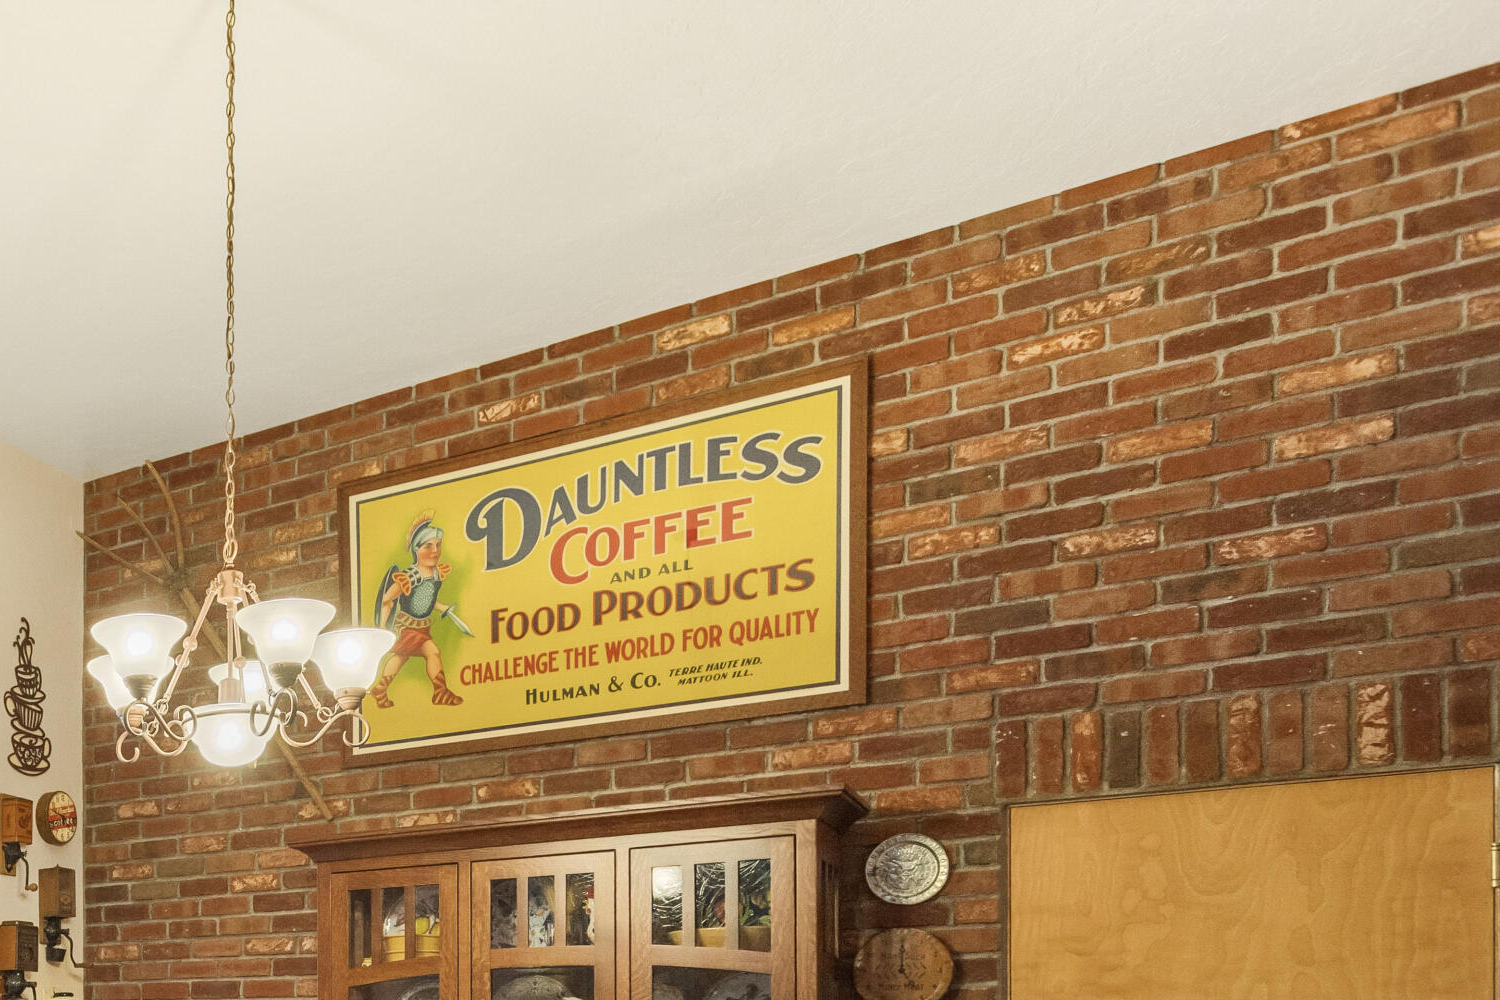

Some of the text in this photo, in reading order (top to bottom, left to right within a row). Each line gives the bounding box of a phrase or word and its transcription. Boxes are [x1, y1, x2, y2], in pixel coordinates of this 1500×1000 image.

[465, 432, 823, 571] DAUNTLESS
[550, 497, 752, 585] COFFEE
[610, 559, 693, 584] AND ALL
[491, 558, 816, 644] FOOD PRODUCTS
[460, 608, 820, 686] CHALLENGE THE WORLD FOR QUALITY
[668, 656, 763, 677] TERRE HAUTE IND.
[525, 683, 600, 705] HULMAN
[608, 676, 624, 693] &
[677, 669, 754, 686] MATTOON ILL.
